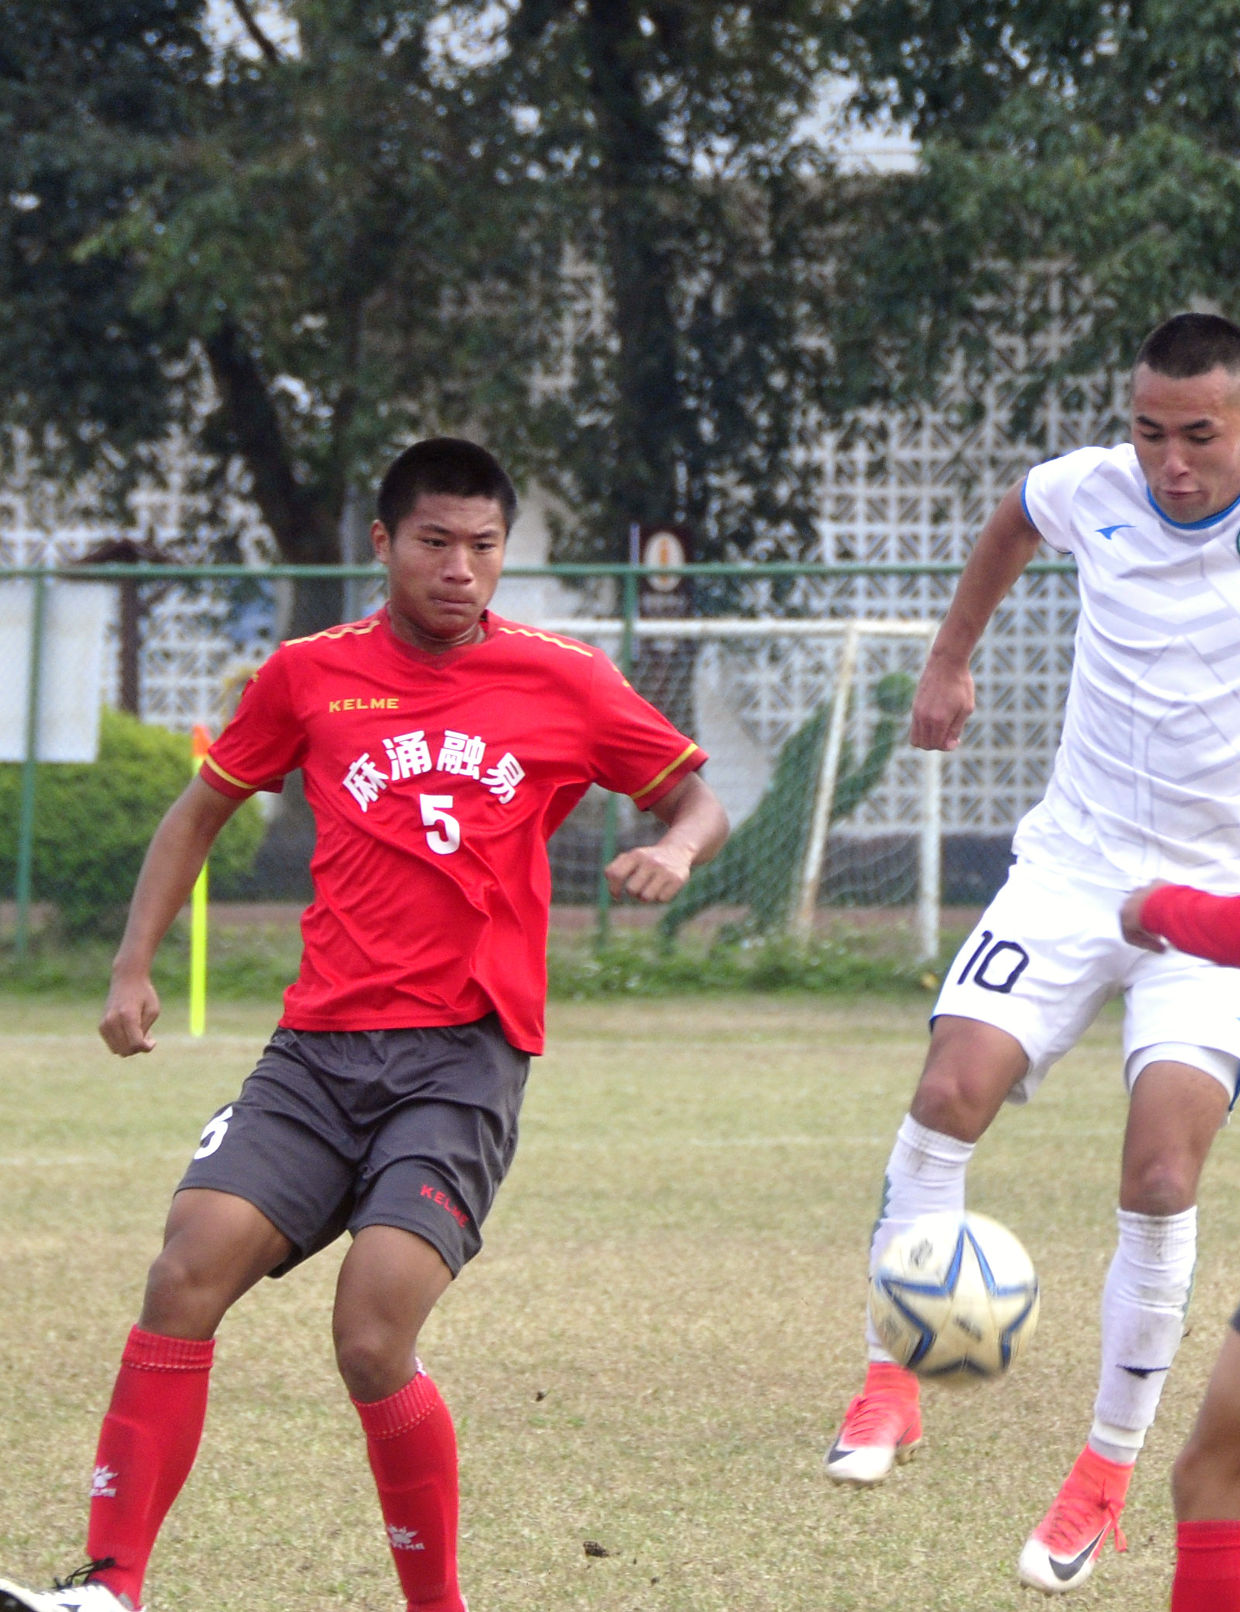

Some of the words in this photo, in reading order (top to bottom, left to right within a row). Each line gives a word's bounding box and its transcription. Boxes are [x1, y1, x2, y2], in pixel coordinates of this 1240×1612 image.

[329, 698, 399, 713] KELME
[342, 729, 526, 813] 麻涌融易
[419, 793, 461, 855] 5
[957, 930, 1030, 994] 10
